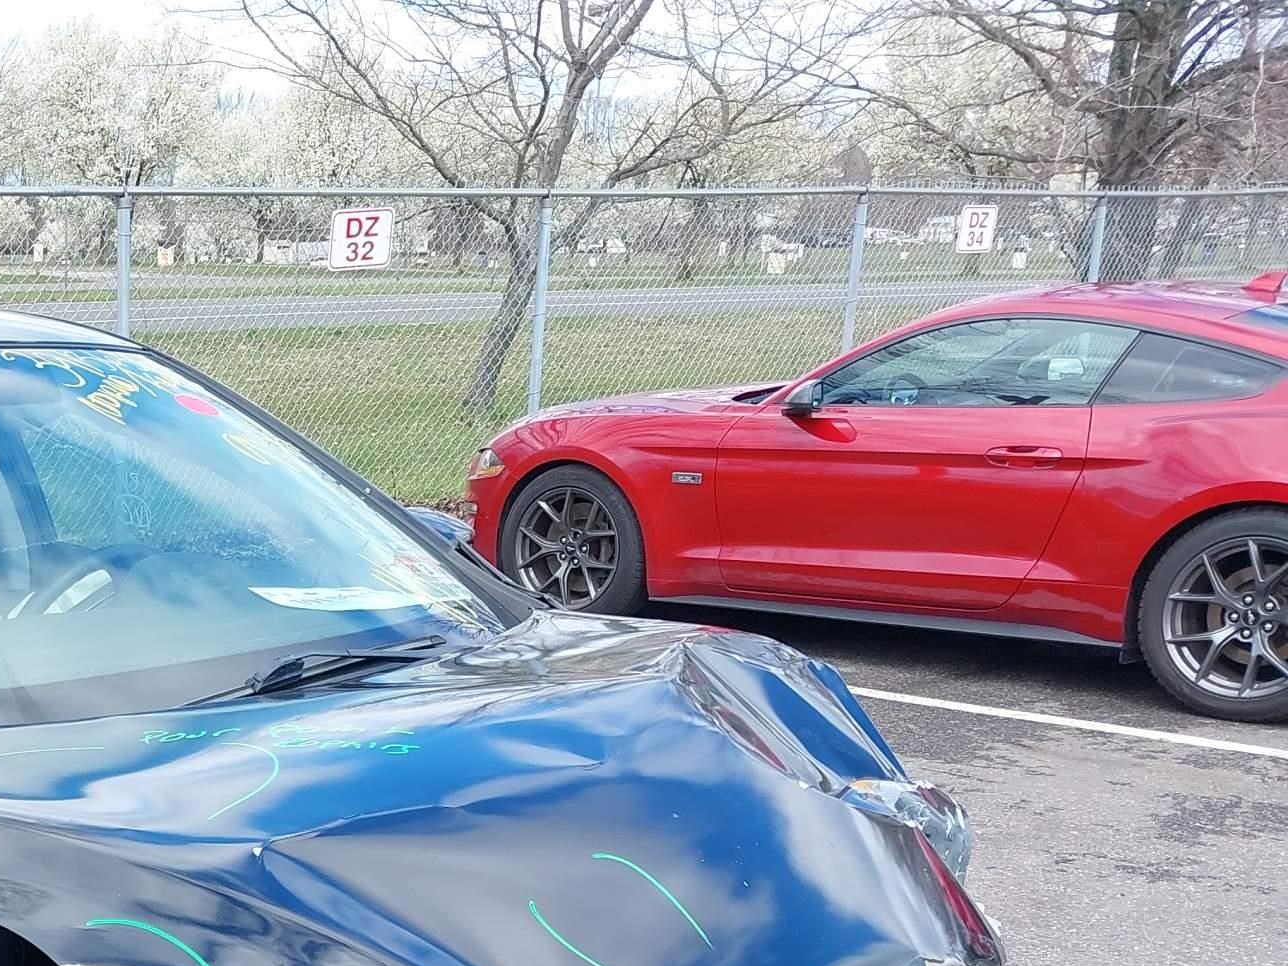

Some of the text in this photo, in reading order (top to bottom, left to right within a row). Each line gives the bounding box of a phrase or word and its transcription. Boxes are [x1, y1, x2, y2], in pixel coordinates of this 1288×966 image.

[345, 216, 380, 239] DZ
[969, 212, 990, 228] DZ
[966, 231, 984, 247] 34
[345, 241, 375, 262] 32
